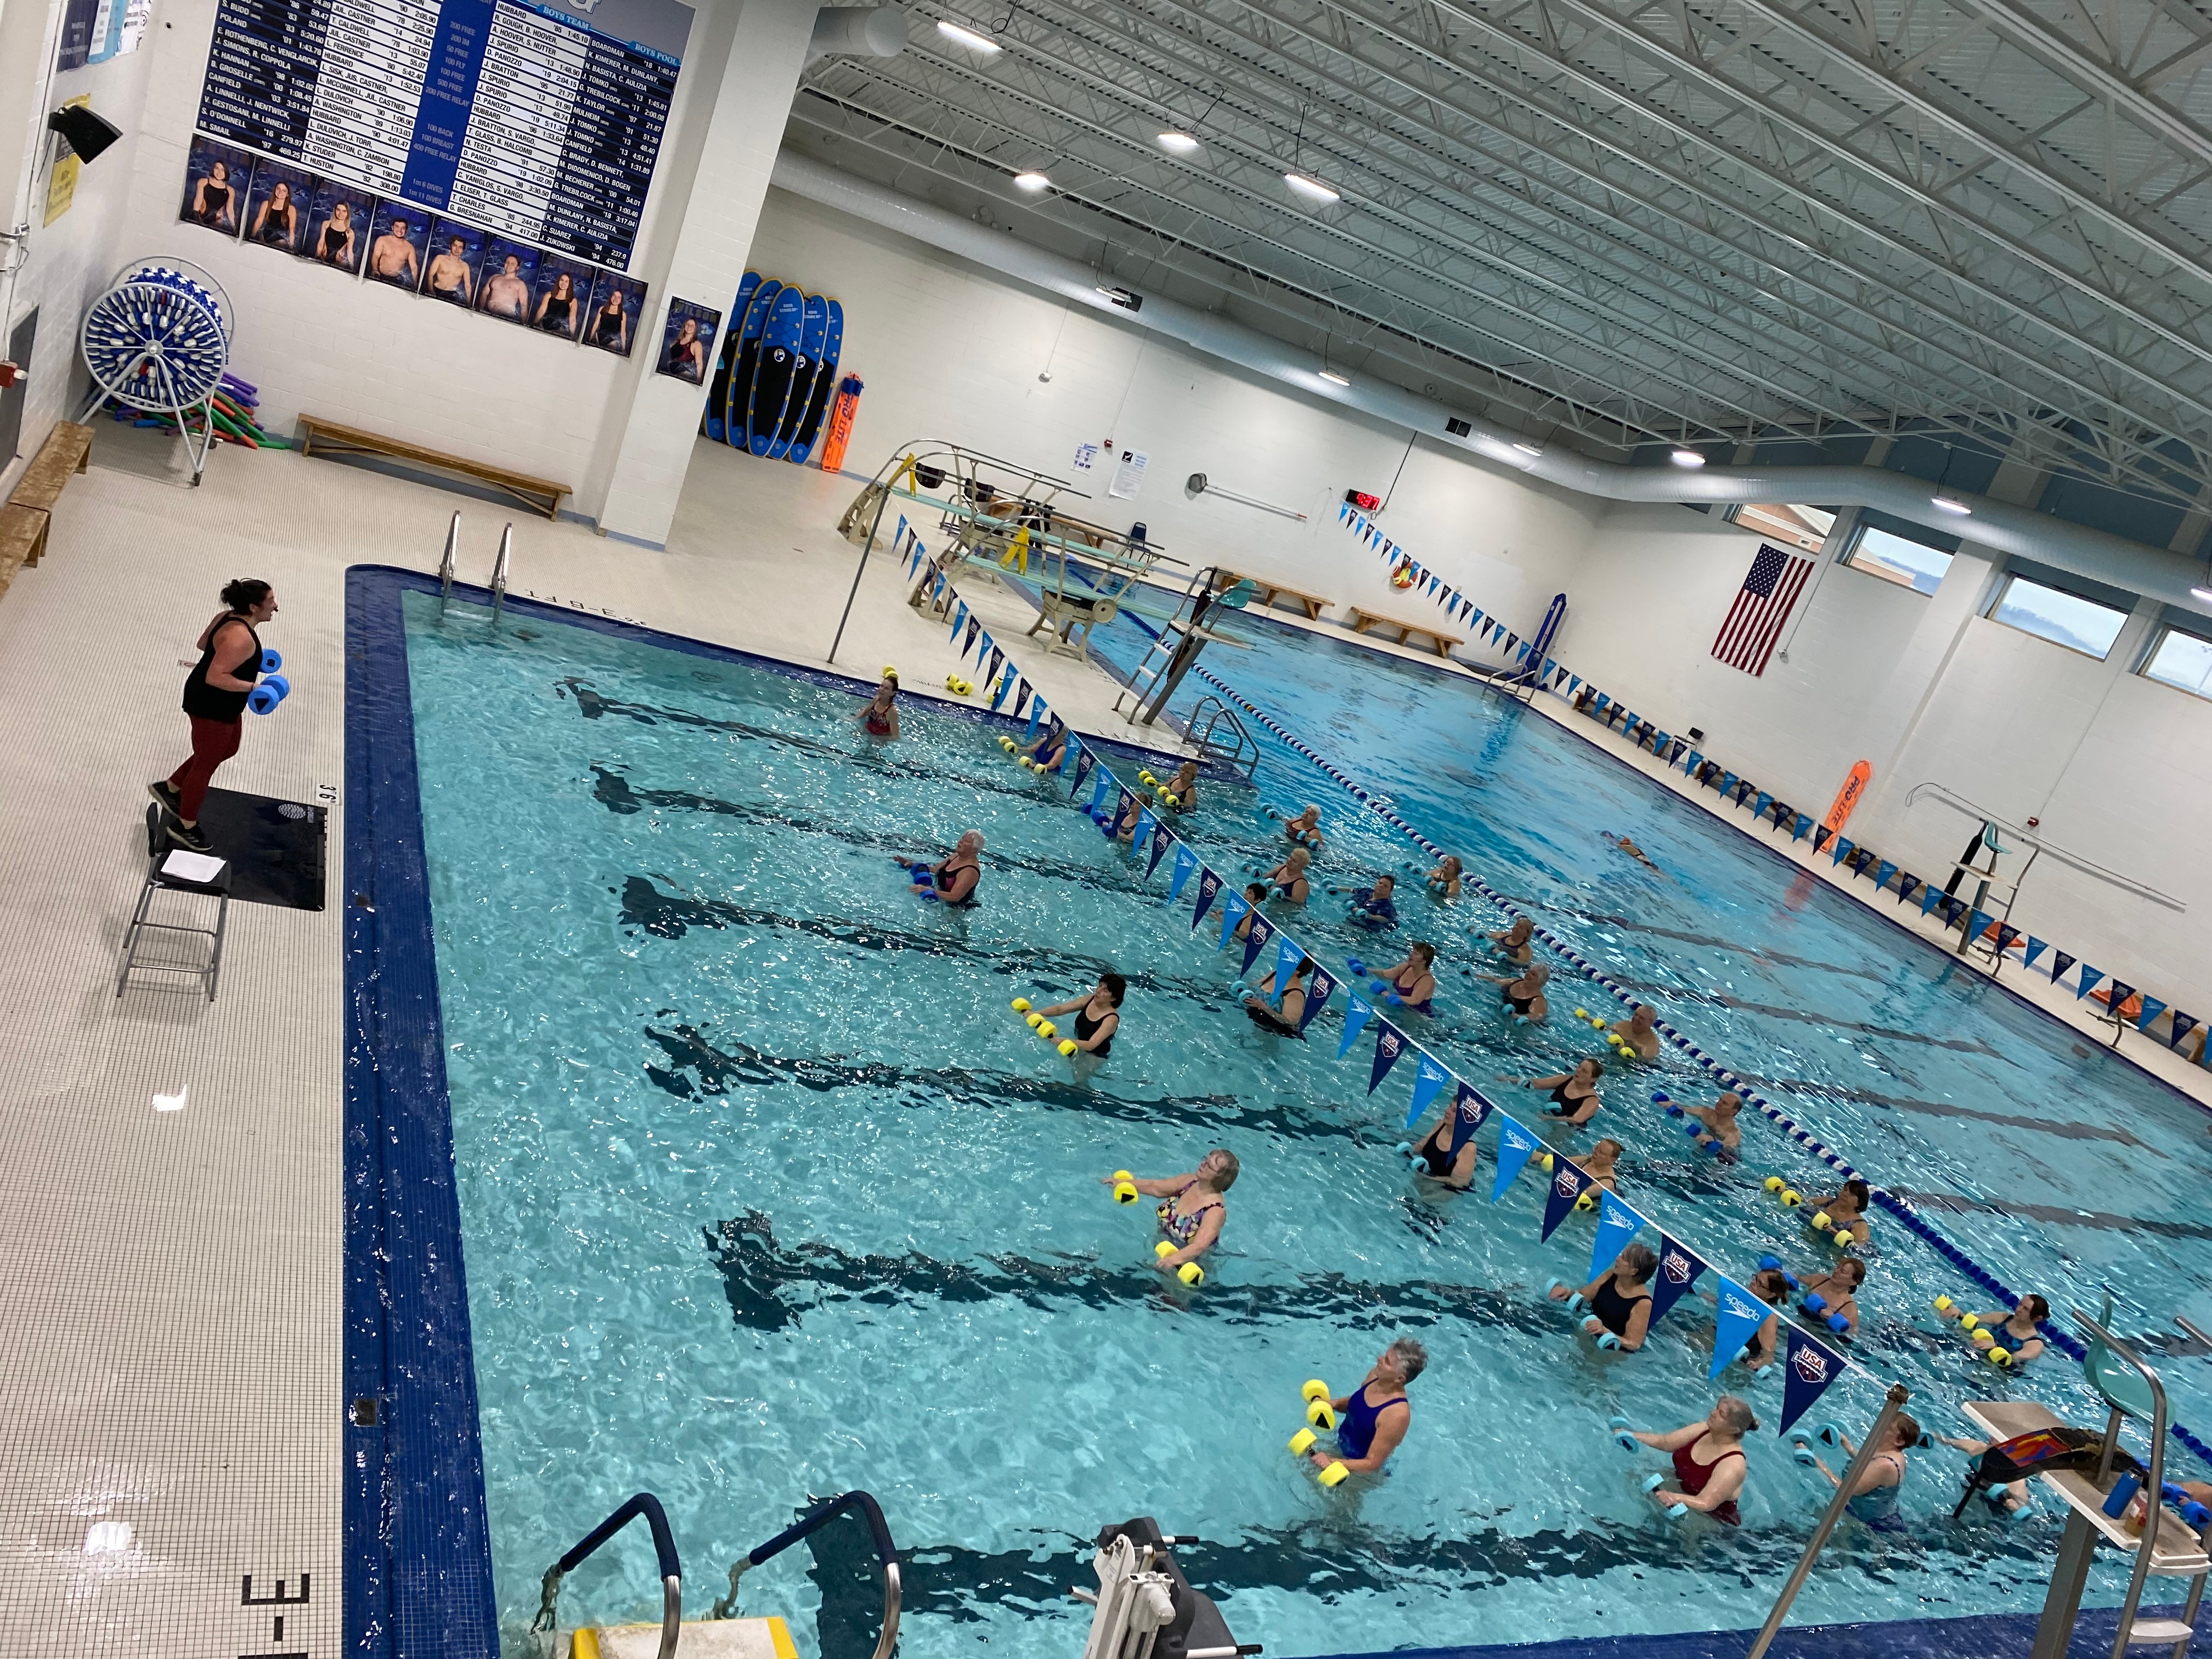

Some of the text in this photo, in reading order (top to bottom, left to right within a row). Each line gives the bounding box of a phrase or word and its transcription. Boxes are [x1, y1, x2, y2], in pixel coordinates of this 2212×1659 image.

[494, 14, 502, 22] R.
[502, 17, 524, 32] GOUGH,
[533, 29, 557, 45] HOOVER,
[498, 3, 527, 19] HUBBARD
[568, 30, 588, 43] 1:45.10
[543, 6, 589, 30] BOYS TEAM
[499, 28, 524, 44] HOOVER,
[533, 42, 556, 56] NUTTER
[489, 37, 580, 77] J. SPURIO SPURIO 1:48.90
[494, 51, 522, 67] PANOZZO
[556, 75, 577, 88] 2:04.15
[490, 63, 519, 78] BRATTON
[558, 88, 574, 99] 21.77
[323, 89, 353, 105] DULOVICH
[393, 114, 413, 127] 1:06.90
[312, 109, 341, 125] HUBBARD
[387, 136, 409, 148] 4:01.47
[473, 105, 501, 120] HUBBARD
[543, 131, 563, 143] 1:33.64
[477, 119, 506, 135] BRATTON,
[515, 132, 535, 146] VARGO,
[315, 134, 356, 155] WASHINGTON,
[364, 151, 390, 166] ZAMBON
[475, 130, 495, 143] GLASS,
[504, 140, 533, 156] HALCOMB
[312, 145, 336, 159] STUDER
[382, 170, 401, 181] 198.80
[470, 152, 498, 167] PANOZZO
[532, 174, 552, 186] 1:02.09
[473, 141, 492, 153] TESTA
[539, 165, 555, 176] 57.30
[309, 157, 334, 171] HUSTON
[379, 181, 399, 193] 308.00
[460, 160, 487, 175] HUBBARD
[528, 185, 549, 198] 3:30.50
[466, 173, 495, 191] YANIGLOS,
[504, 187, 524, 201] VARGO,
[460, 184, 481, 198] ELISER,
[489, 195, 509, 206] GLASS
[456, 206, 493, 223] BRESNAHAN
[519, 228, 538, 239] 417.00
[459, 196, 486, 210] CHARLES
[521, 218, 540, 229] 244.95
[1831, 775, 1860, 827] PRO-LITE
[1230, 898, 1245, 913] speedo
[1256, 926, 1266, 935] USA
[1283, 946, 1300, 964] speedo
[1317, 978, 1327, 988] USA
[1352, 996, 1371, 1014] speedo
[1386, 1035, 1397, 1047] USA
[1422, 1062, 1444, 1083] speedo
[1466, 1098, 1479, 1113] USA
[1505, 1129, 1532, 1152] speedo
[1562, 1171, 1576, 1186] USA
[1606, 1204, 1634, 1231] speedo
[1672, 1254, 1686, 1270] USA
[1724, 1293, 1760, 1322] speedo
[1794, 1355, 1827, 1379] SWIMMING
[1803, 1350, 1822, 1369] USA
